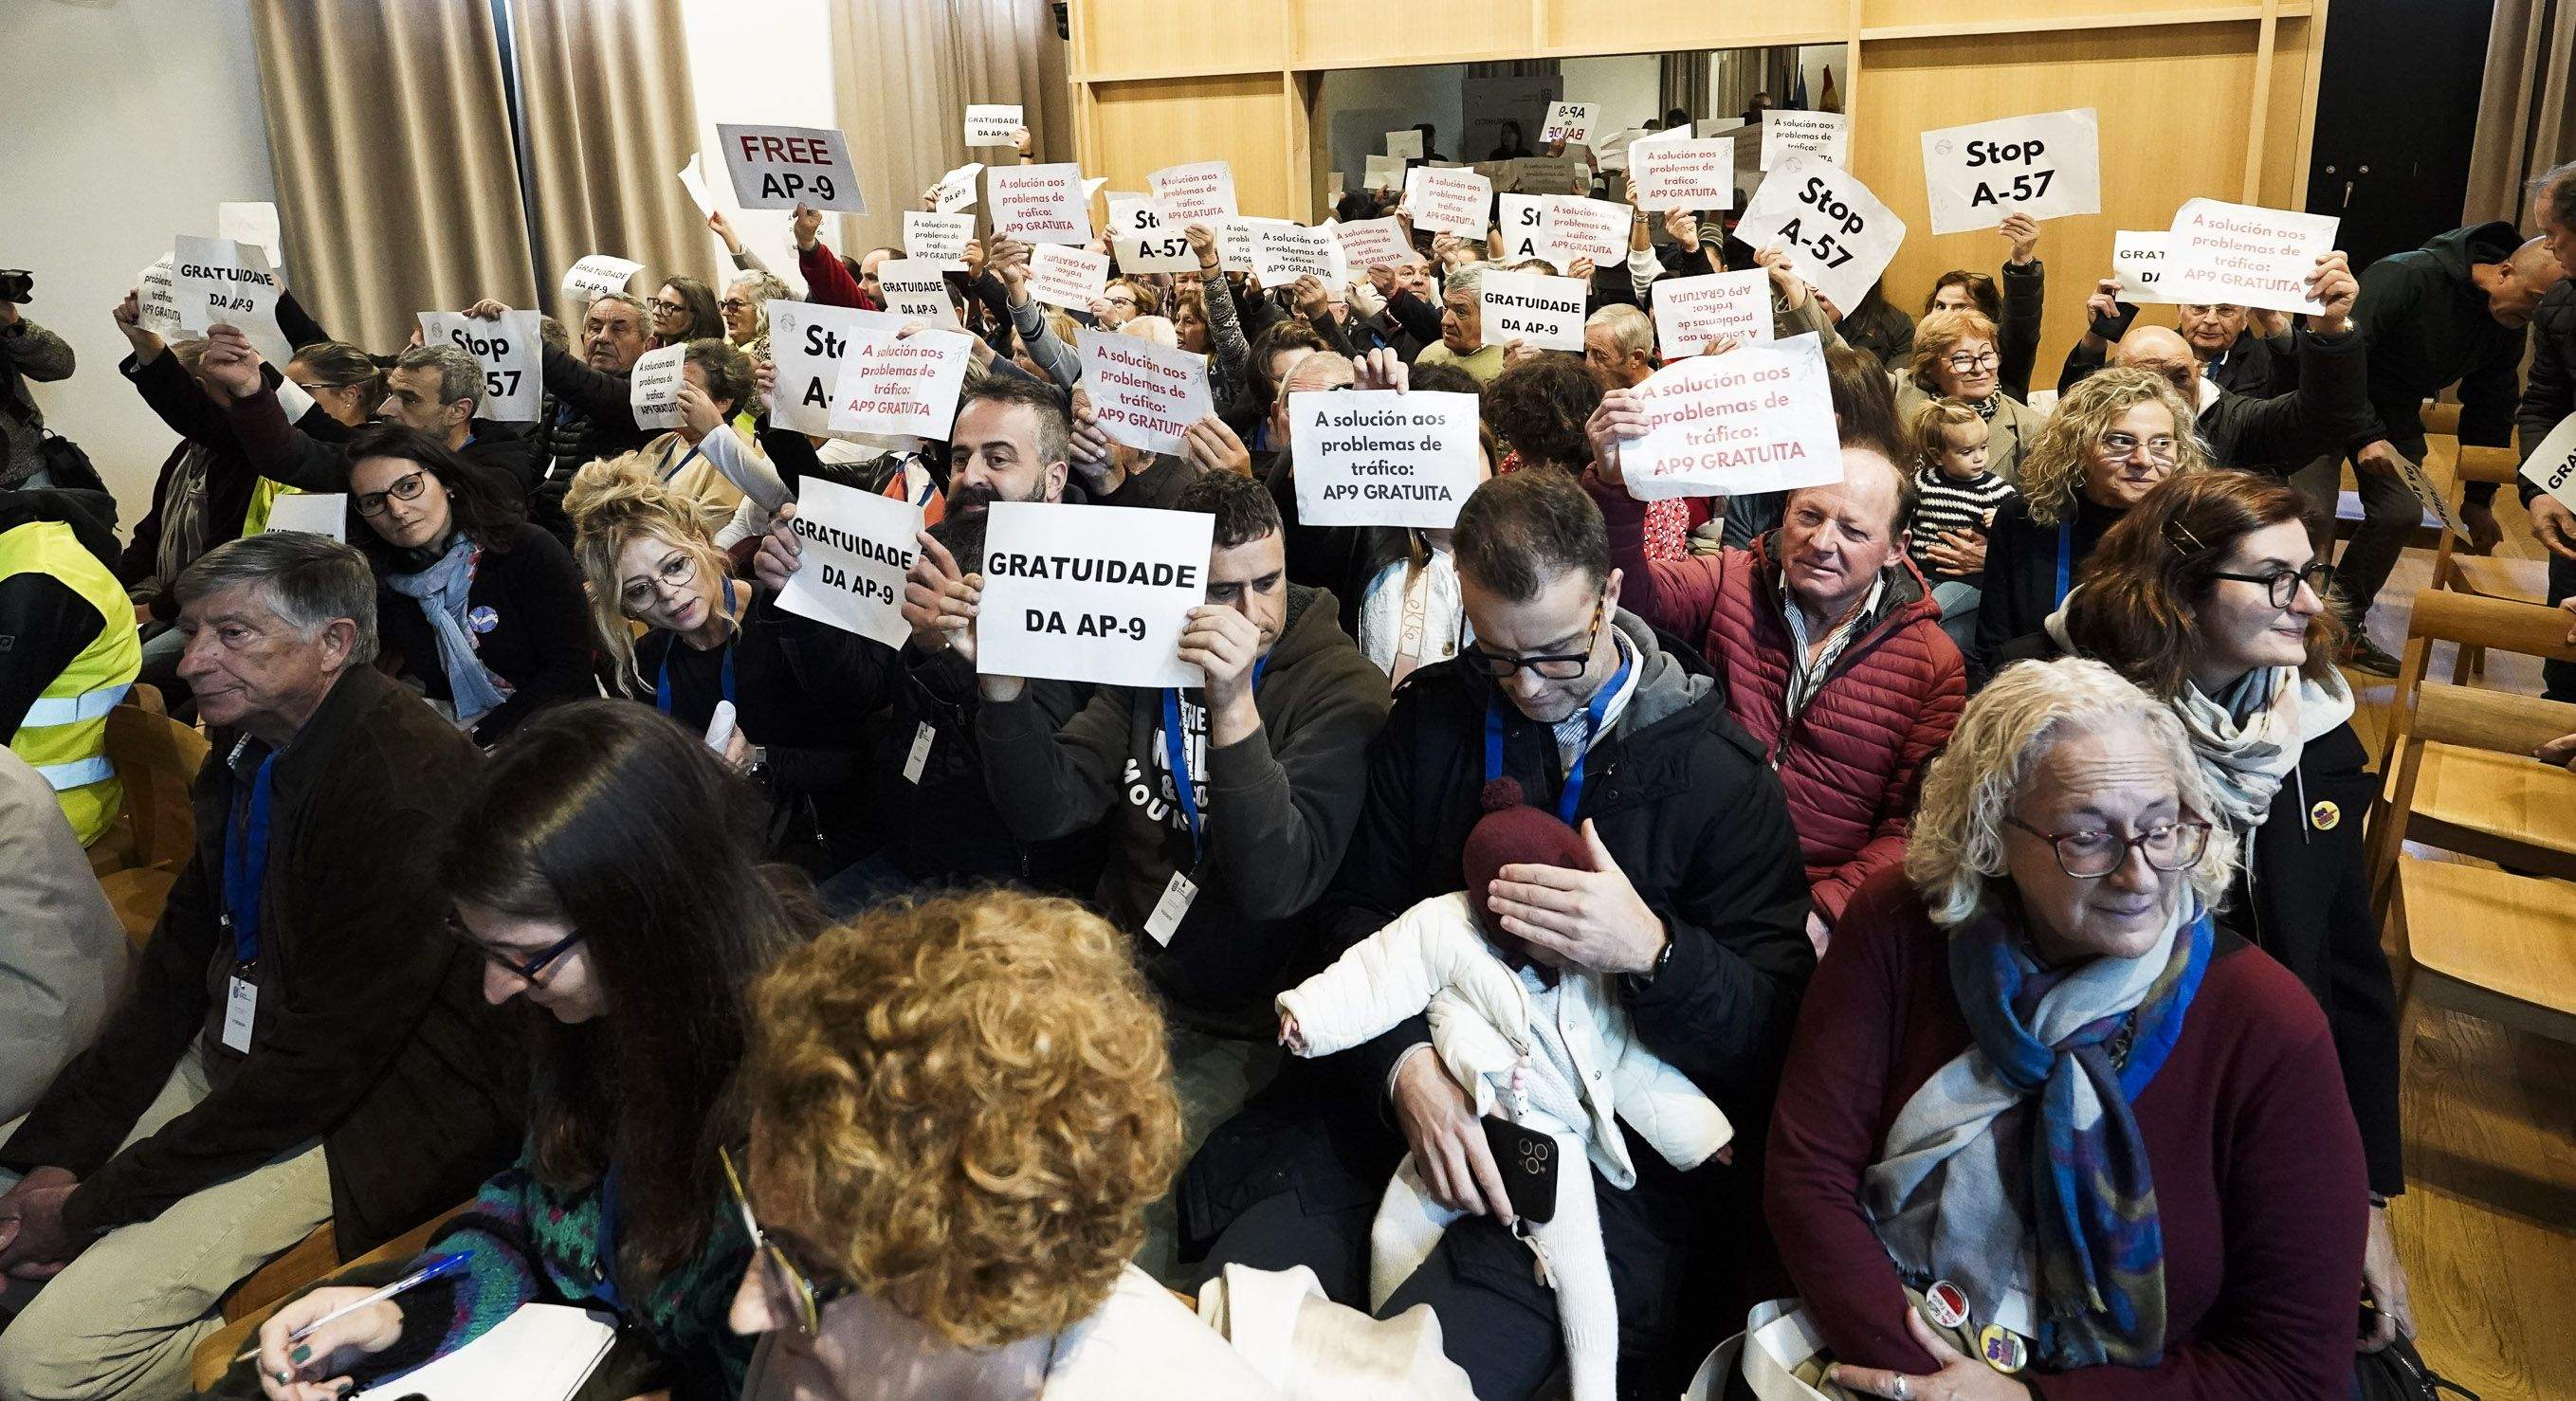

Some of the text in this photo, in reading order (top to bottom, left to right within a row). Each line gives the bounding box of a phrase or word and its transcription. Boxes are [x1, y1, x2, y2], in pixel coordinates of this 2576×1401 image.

[1783, 119, 1817, 129] solución
[740, 136, 832, 165] FREE
[1657, 151, 1696, 159] solución
[1966, 139, 2044, 167] Stop
[1651, 164, 1699, 174] problemas
[762, 173, 834, 201] AP-9
[1000, 179, 1007, 189] A
[1009, 178, 1044, 189] solución
[1168, 175, 1199, 185] solución
[1436, 178, 1466, 189] solución
[1467, 184, 1481, 192] aos
[1665, 176, 1697, 185] tráfico:
[1164, 188, 1204, 198] problemas
[1429, 191, 1476, 203] problemas de
[1671, 189, 1717, 197] GRATUITA
[1971, 170, 2055, 208] A-57
[1002, 192, 1065, 206] problemas de
[1178, 199, 1205, 208] tráfico:
[1438, 203, 1463, 211] tráfico:
[1799, 177, 1863, 235] Stop
[1018, 209, 1051, 218] tráfico:
[1135, 210, 1160, 229] St
[1183, 208, 1224, 219] GRATUITA
[1426, 211, 1475, 227] AP9 GRATUITA
[1521, 207, 1541, 227] St
[1562, 207, 1597, 216] solución
[1006, 221, 1074, 233] AP9 GRATUITA
[1554, 219, 1599, 229] problemas
[2193, 213, 2306, 240] A solución aos
[1263, 232, 1270, 241] A
[1272, 234, 1311, 245] solución
[1344, 228, 1374, 238] solución
[1566, 231, 1596, 241] tráfico:
[1140, 239, 1188, 258] A-57
[1266, 246, 1315, 256] problemas
[1343, 238, 1381, 249] problemas
[1551, 241, 1612, 255] AP9 GRATUITA
[1778, 217, 1854, 269] A-57
[2193, 237, 2300, 257] problemas de
[1365, 253, 1402, 264] GRATUITA
[2215, 257, 2270, 272] tráfico:
[181, 264, 274, 286] GRATUIDADE
[575, 264, 628, 280] GRATUIDADE
[1267, 264, 1332, 279] AP9 GRATUITA
[575, 280, 608, 293] DA AP-9
[883, 282, 943, 292] GRATUIDADE
[2184, 268, 2301, 293] AP9 GRATUITA
[1670, 285, 1750, 302] AP9 GRATUITA
[210, 294, 253, 312] DA AP-9
[902, 305, 937, 314] DA AP-9
[1485, 292, 1580, 313] GRATUIDADE
[1502, 318, 1558, 335] DA AP-9
[1678, 313, 1752, 330] problemas de
[451, 329, 509, 362] Stop
[804, 325, 846, 359] St
[862, 345, 943, 359] A solución aos
[861, 364, 936, 377] problemas de
[1097, 345, 1186, 379] A solución aos
[484, 371, 521, 397] -57
[874, 382, 910, 395] tráfico:
[1101, 370, 1186, 398] problemas de
[1641, 365, 1790, 400] A solución aos
[803, 376, 832, 409] A-
[849, 400, 931, 416] AP9 GRATUITA
[1121, 393, 1166, 412] tráfico:
[1651, 391, 1789, 429] problemas de
[1098, 408, 1190, 438] AP9 GRATUITA
[1315, 410, 1445, 427] A solución aos
[1686, 426, 1759, 446] tráfico:
[1322, 435, 1442, 456] problemas de
[1352, 460, 1414, 475] tráfico:
[1653, 442, 1805, 476] AP9 GRATUITA
[2548, 447, 2576, 490] GRA
[1324, 484, 1452, 501] AP9 GRATUITA
[794, 518, 912, 570] GRATUIDADE
[989, 553, 1197, 588] GRATUIDADE
[822, 564, 893, 605] DA AP-9
[1026, 609, 1146, 641] DA AP-9
